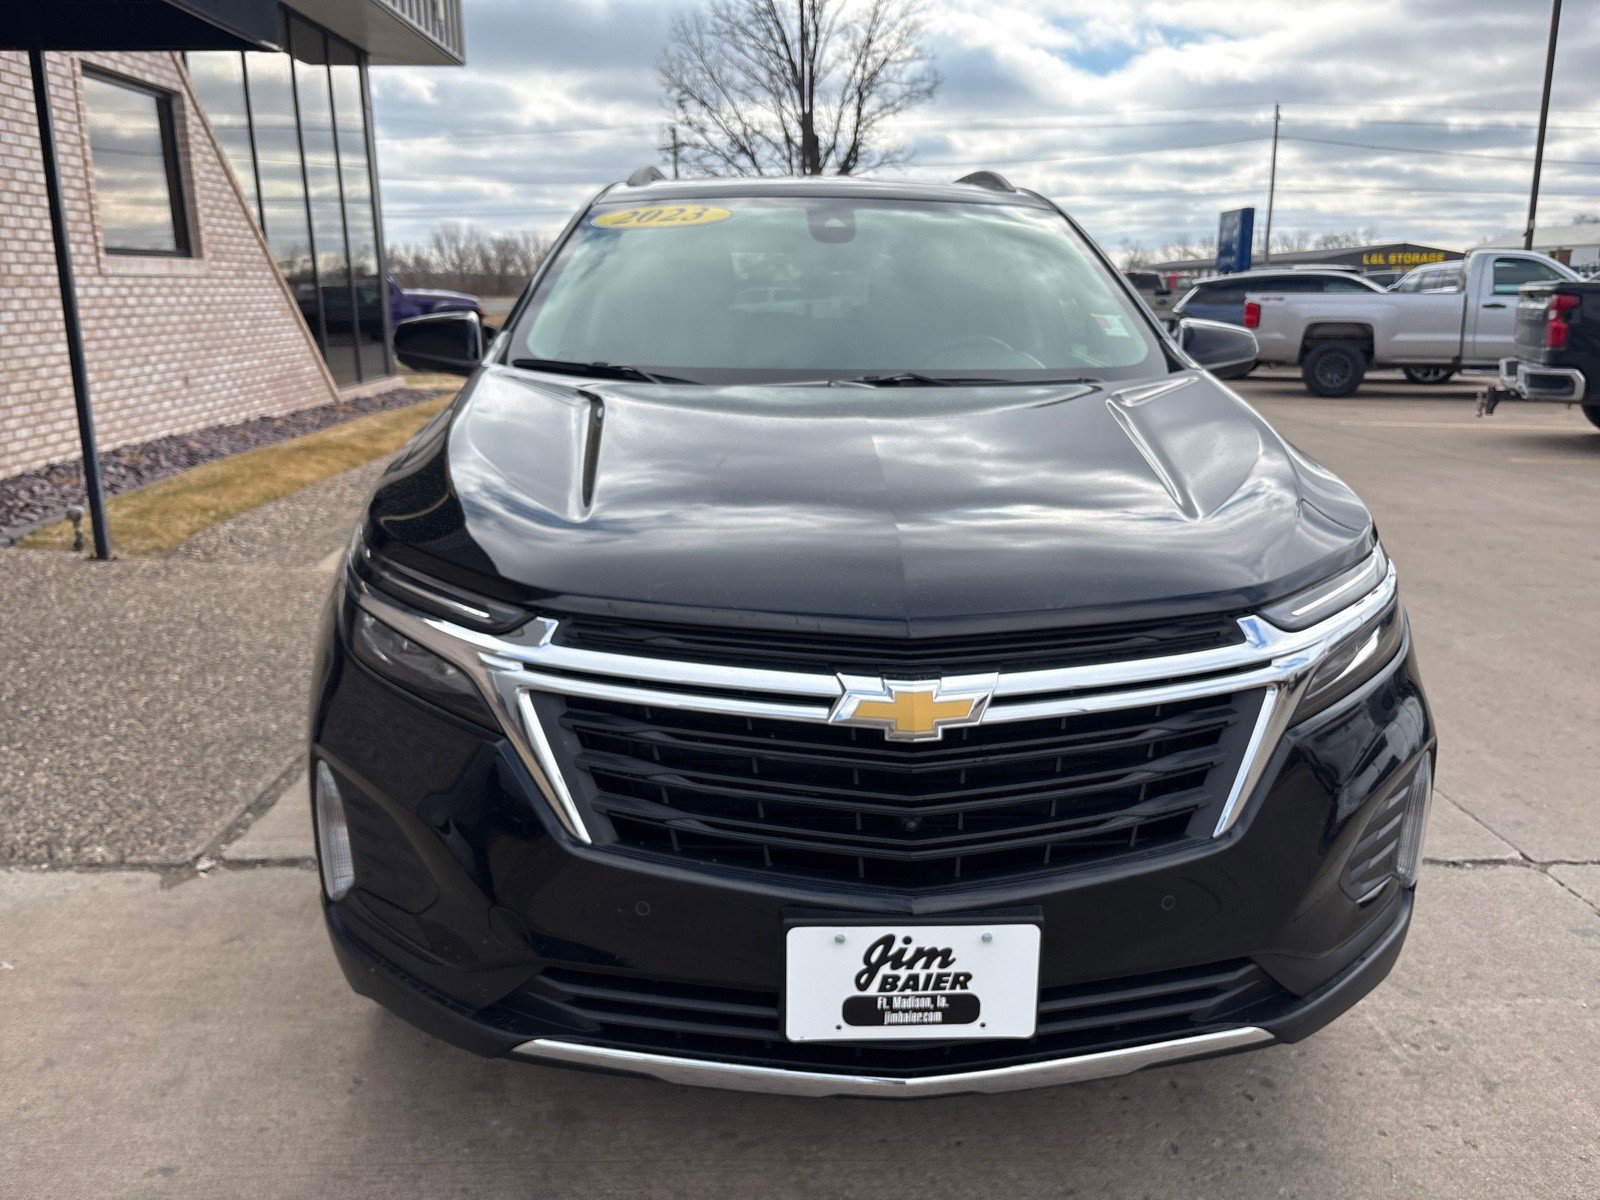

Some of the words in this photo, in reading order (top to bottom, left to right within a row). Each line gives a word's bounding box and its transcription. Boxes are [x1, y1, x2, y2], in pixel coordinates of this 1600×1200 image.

[611, 207, 709, 225] 2023
[1387, 252, 1445, 265] STORAGE
[855, 934, 956, 992] Jim
[877, 972, 972, 993] BAIER
[884, 1010, 942, 1025] jimbaier.com
